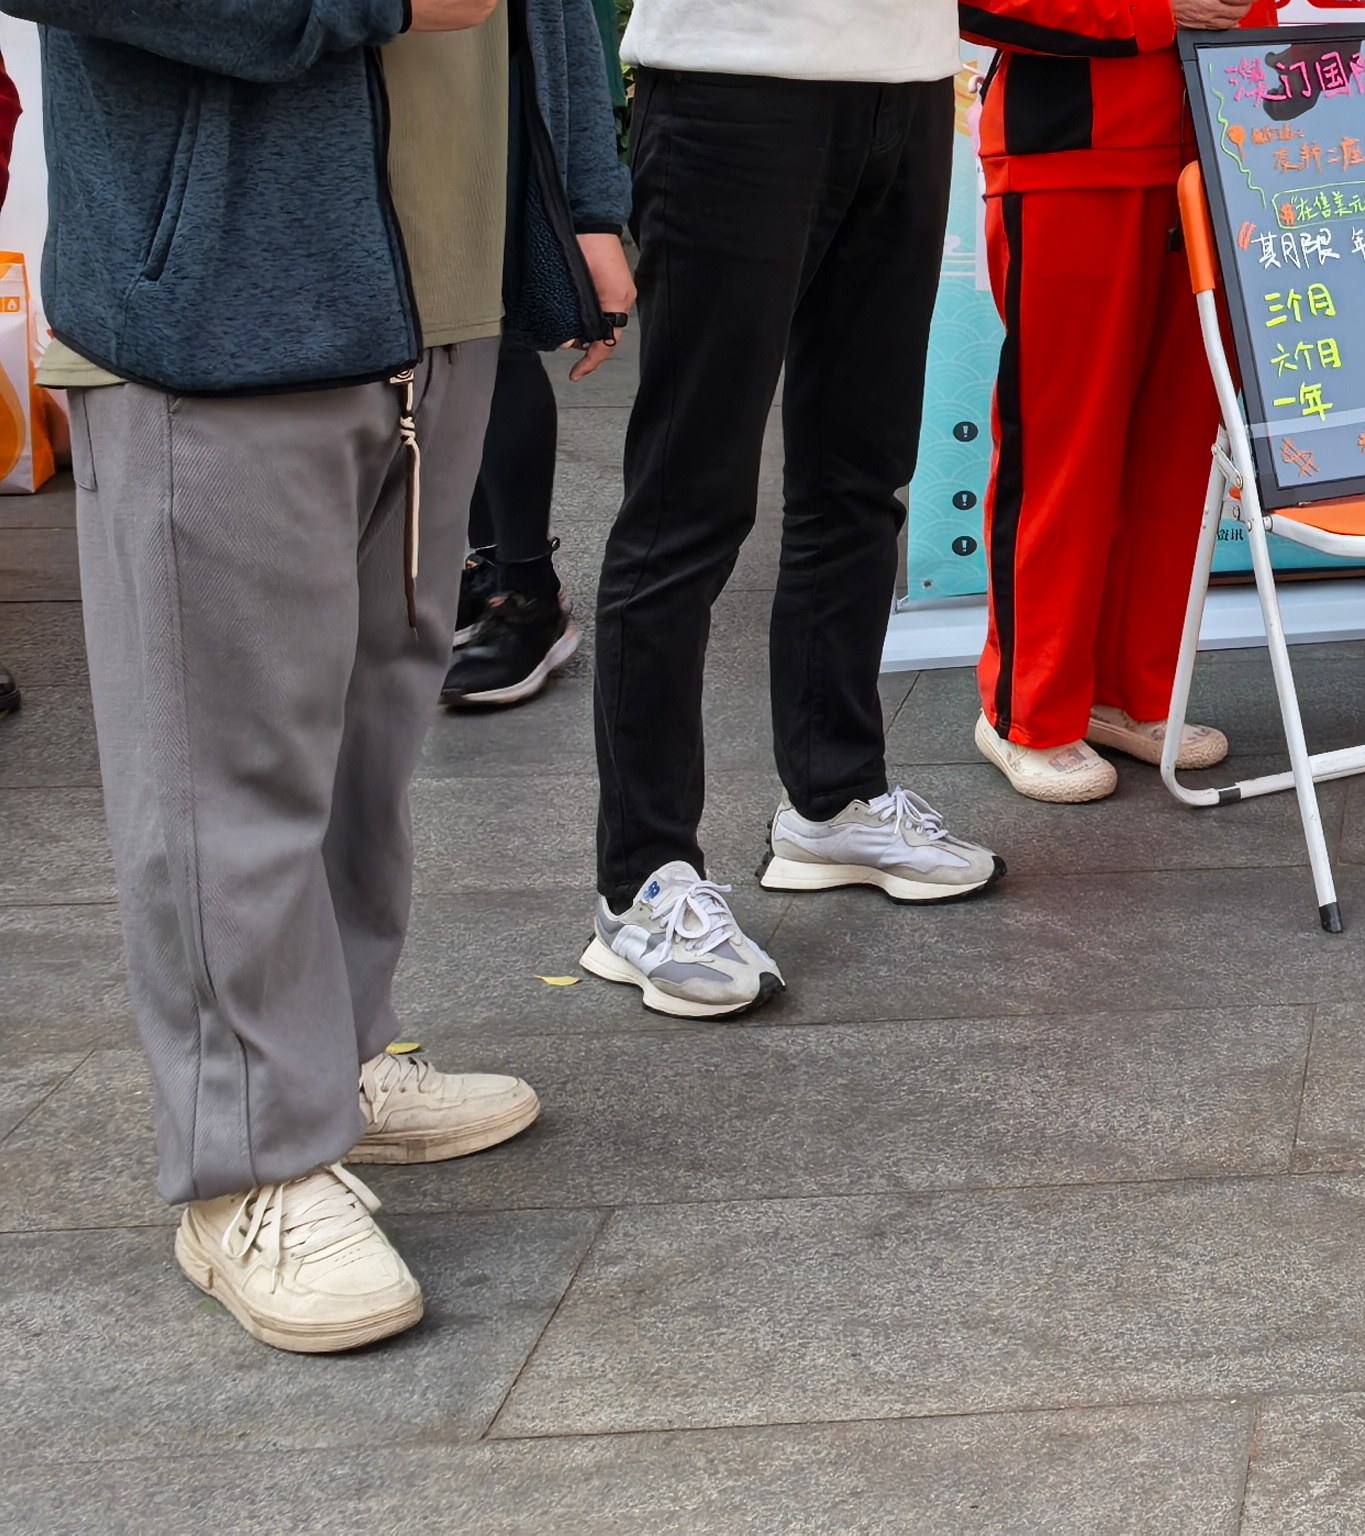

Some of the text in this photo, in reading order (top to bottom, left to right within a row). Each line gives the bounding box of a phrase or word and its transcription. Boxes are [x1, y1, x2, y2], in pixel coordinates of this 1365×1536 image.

[1264, 283, 1336, 327] 三个月
[1270, 338, 1342, 378] 六个月
[1273, 382, 1333, 422] 一年
